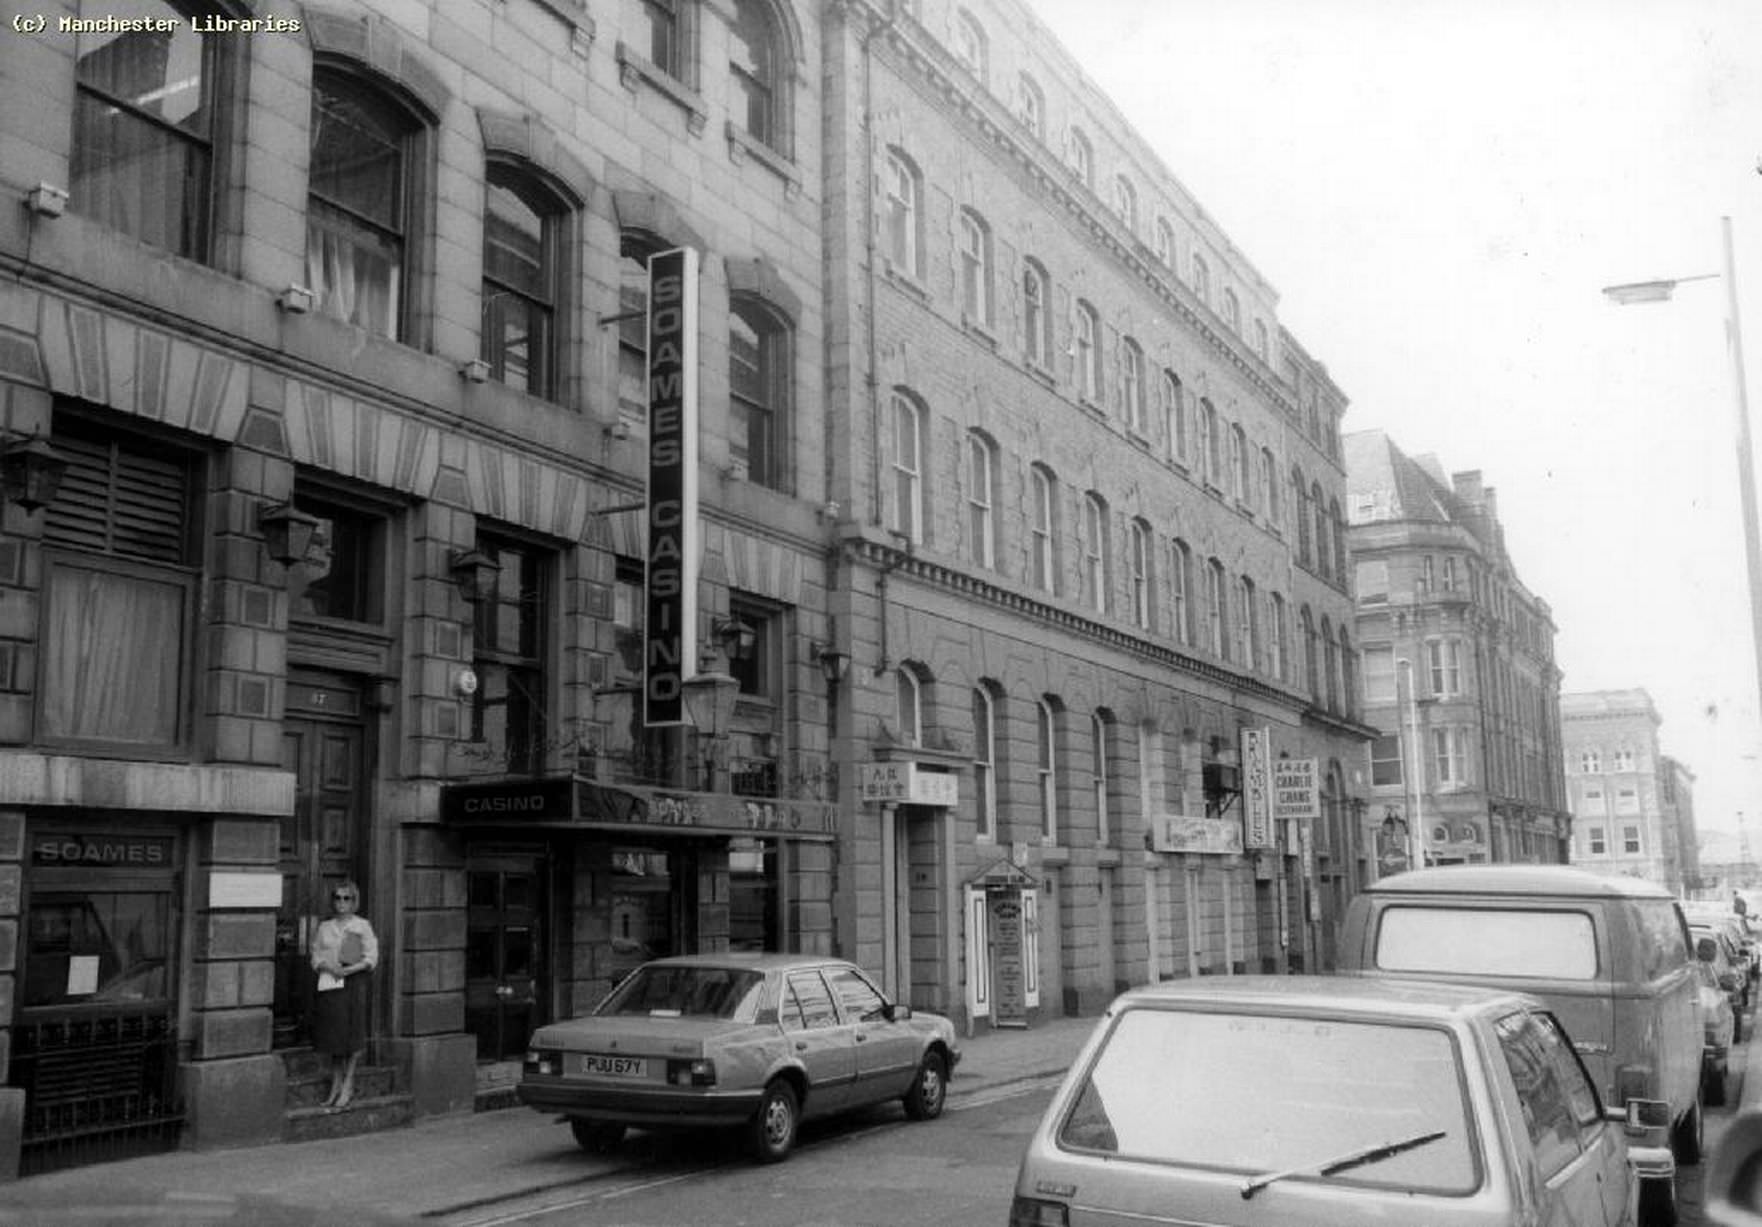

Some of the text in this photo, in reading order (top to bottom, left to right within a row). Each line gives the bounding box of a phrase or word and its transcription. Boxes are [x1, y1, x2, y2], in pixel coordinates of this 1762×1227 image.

[650, 275, 682, 701] SOAMES CASINO
[464, 795, 545, 813] CASINO
[39, 842, 164, 862] SOAMES
